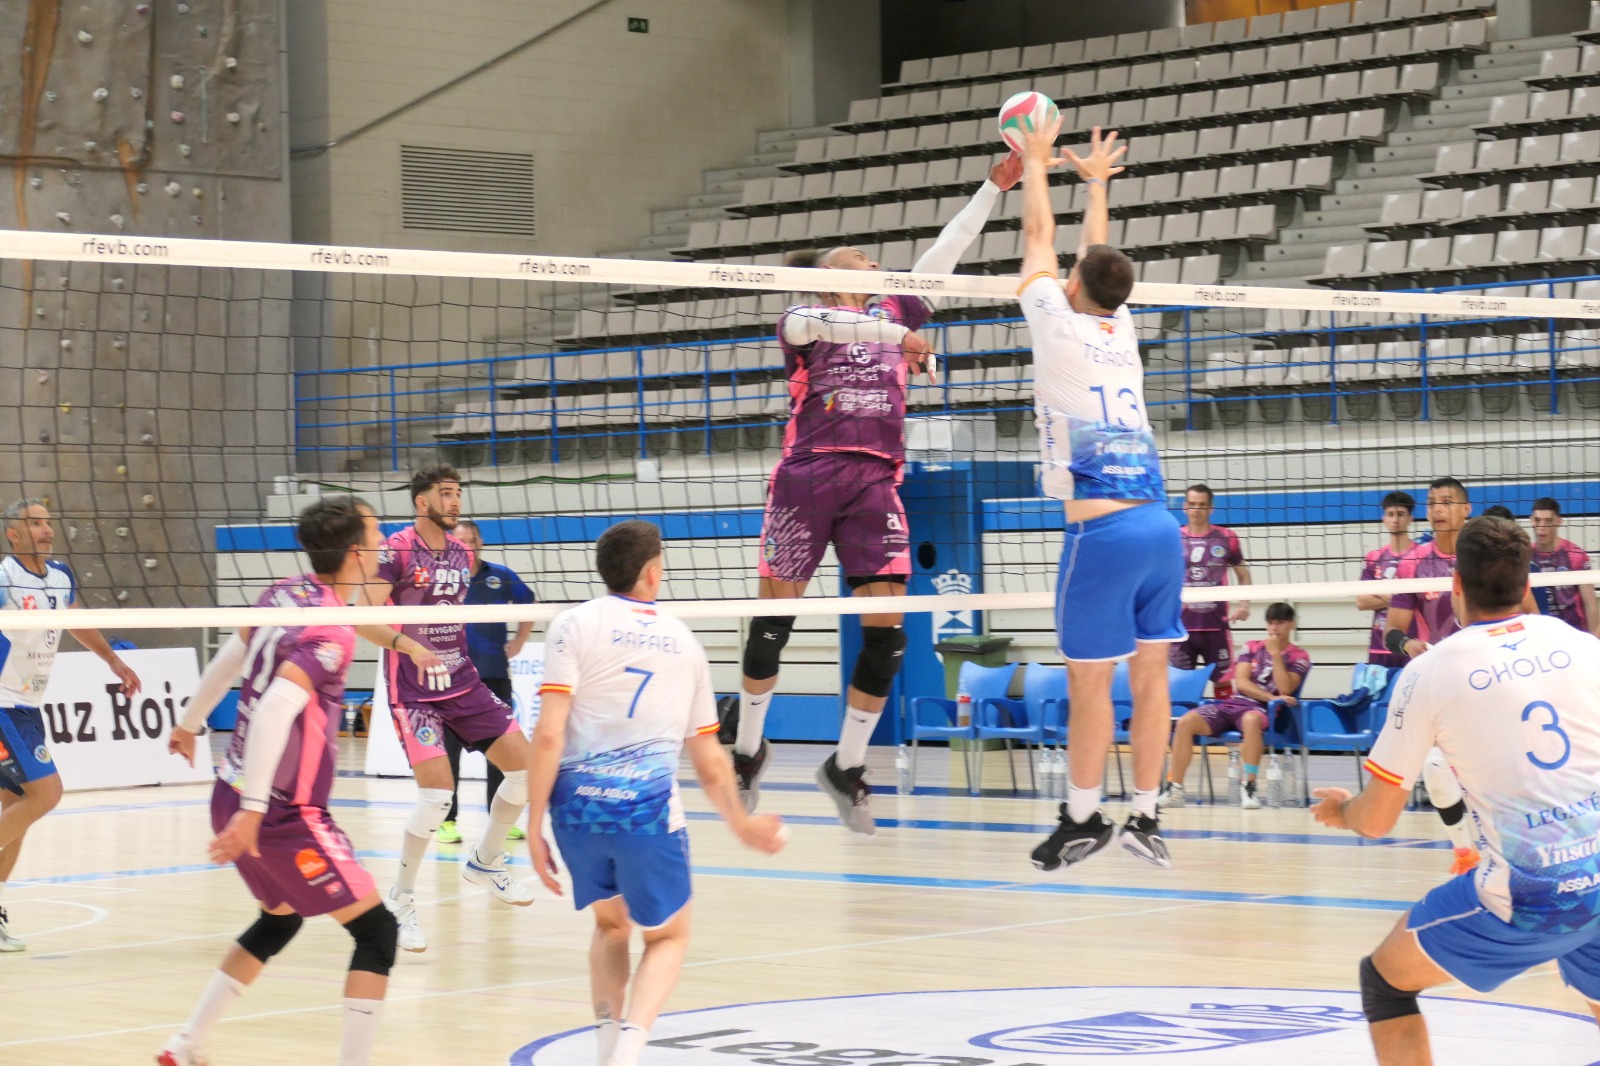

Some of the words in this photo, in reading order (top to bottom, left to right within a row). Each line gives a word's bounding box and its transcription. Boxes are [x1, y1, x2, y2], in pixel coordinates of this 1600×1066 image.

[82, 238, 169, 258] rfevb.com
[310, 248, 390, 268] rfevb.com
[518, 258, 591, 276] rfevb.com
[709, 267, 776, 284] rfevb.com
[883, 275, 945, 291] rfevb.com
[1195, 287, 1247, 302] rfevb.com
[1089, 386, 1144, 430] 13
[432, 568, 461, 596] 29
[418, 624, 464, 635] SERVIGROU
[611, 629, 683, 655] RAFAEL
[1468, 649, 1571, 691] CHOLO
[624, 666, 654, 719] 7
[44, 702, 96, 744] uz
[1521, 700, 1571, 771] 3
[645, 1027, 1065, 1066] Lega
